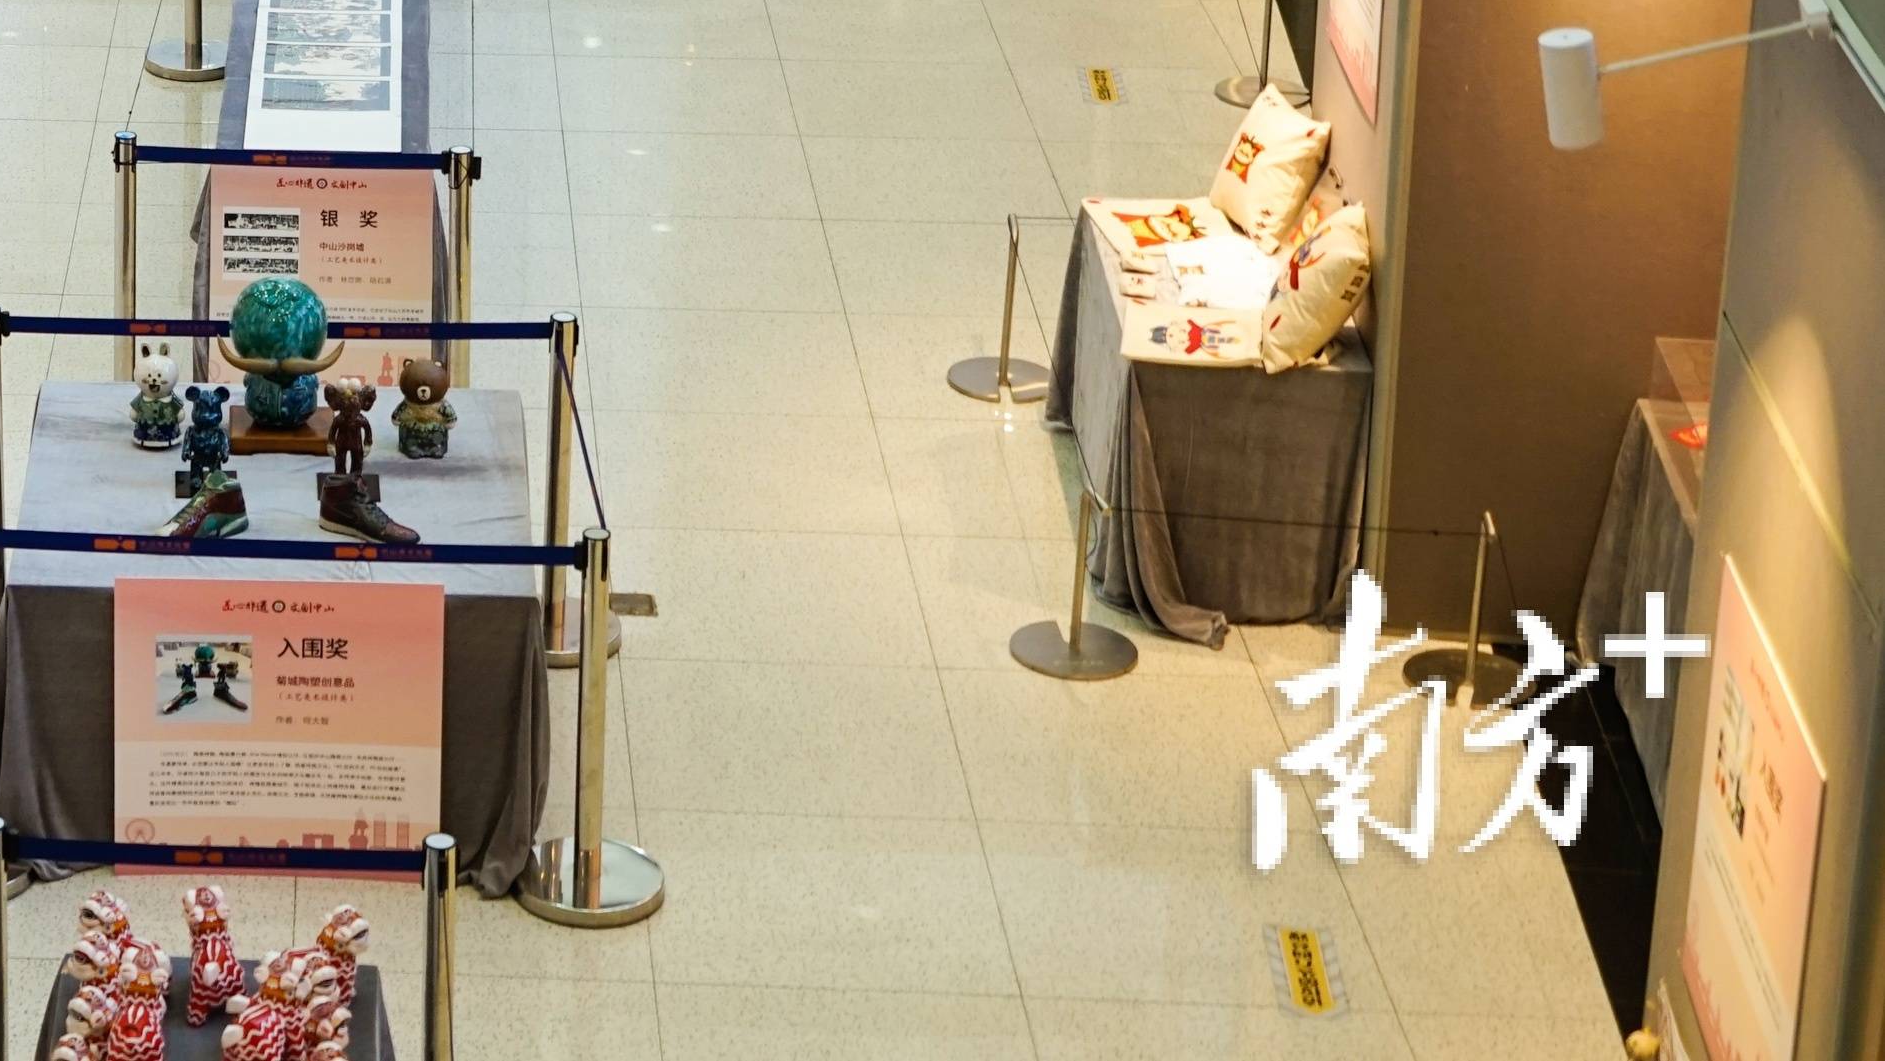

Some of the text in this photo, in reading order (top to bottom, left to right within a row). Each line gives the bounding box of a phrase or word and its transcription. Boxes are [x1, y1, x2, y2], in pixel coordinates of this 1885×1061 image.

[320, 209, 379, 228] 银 奖
[277, 637, 348, 660] 入围奖
[276, 676, 355, 688] 菊城陶塑创意品
